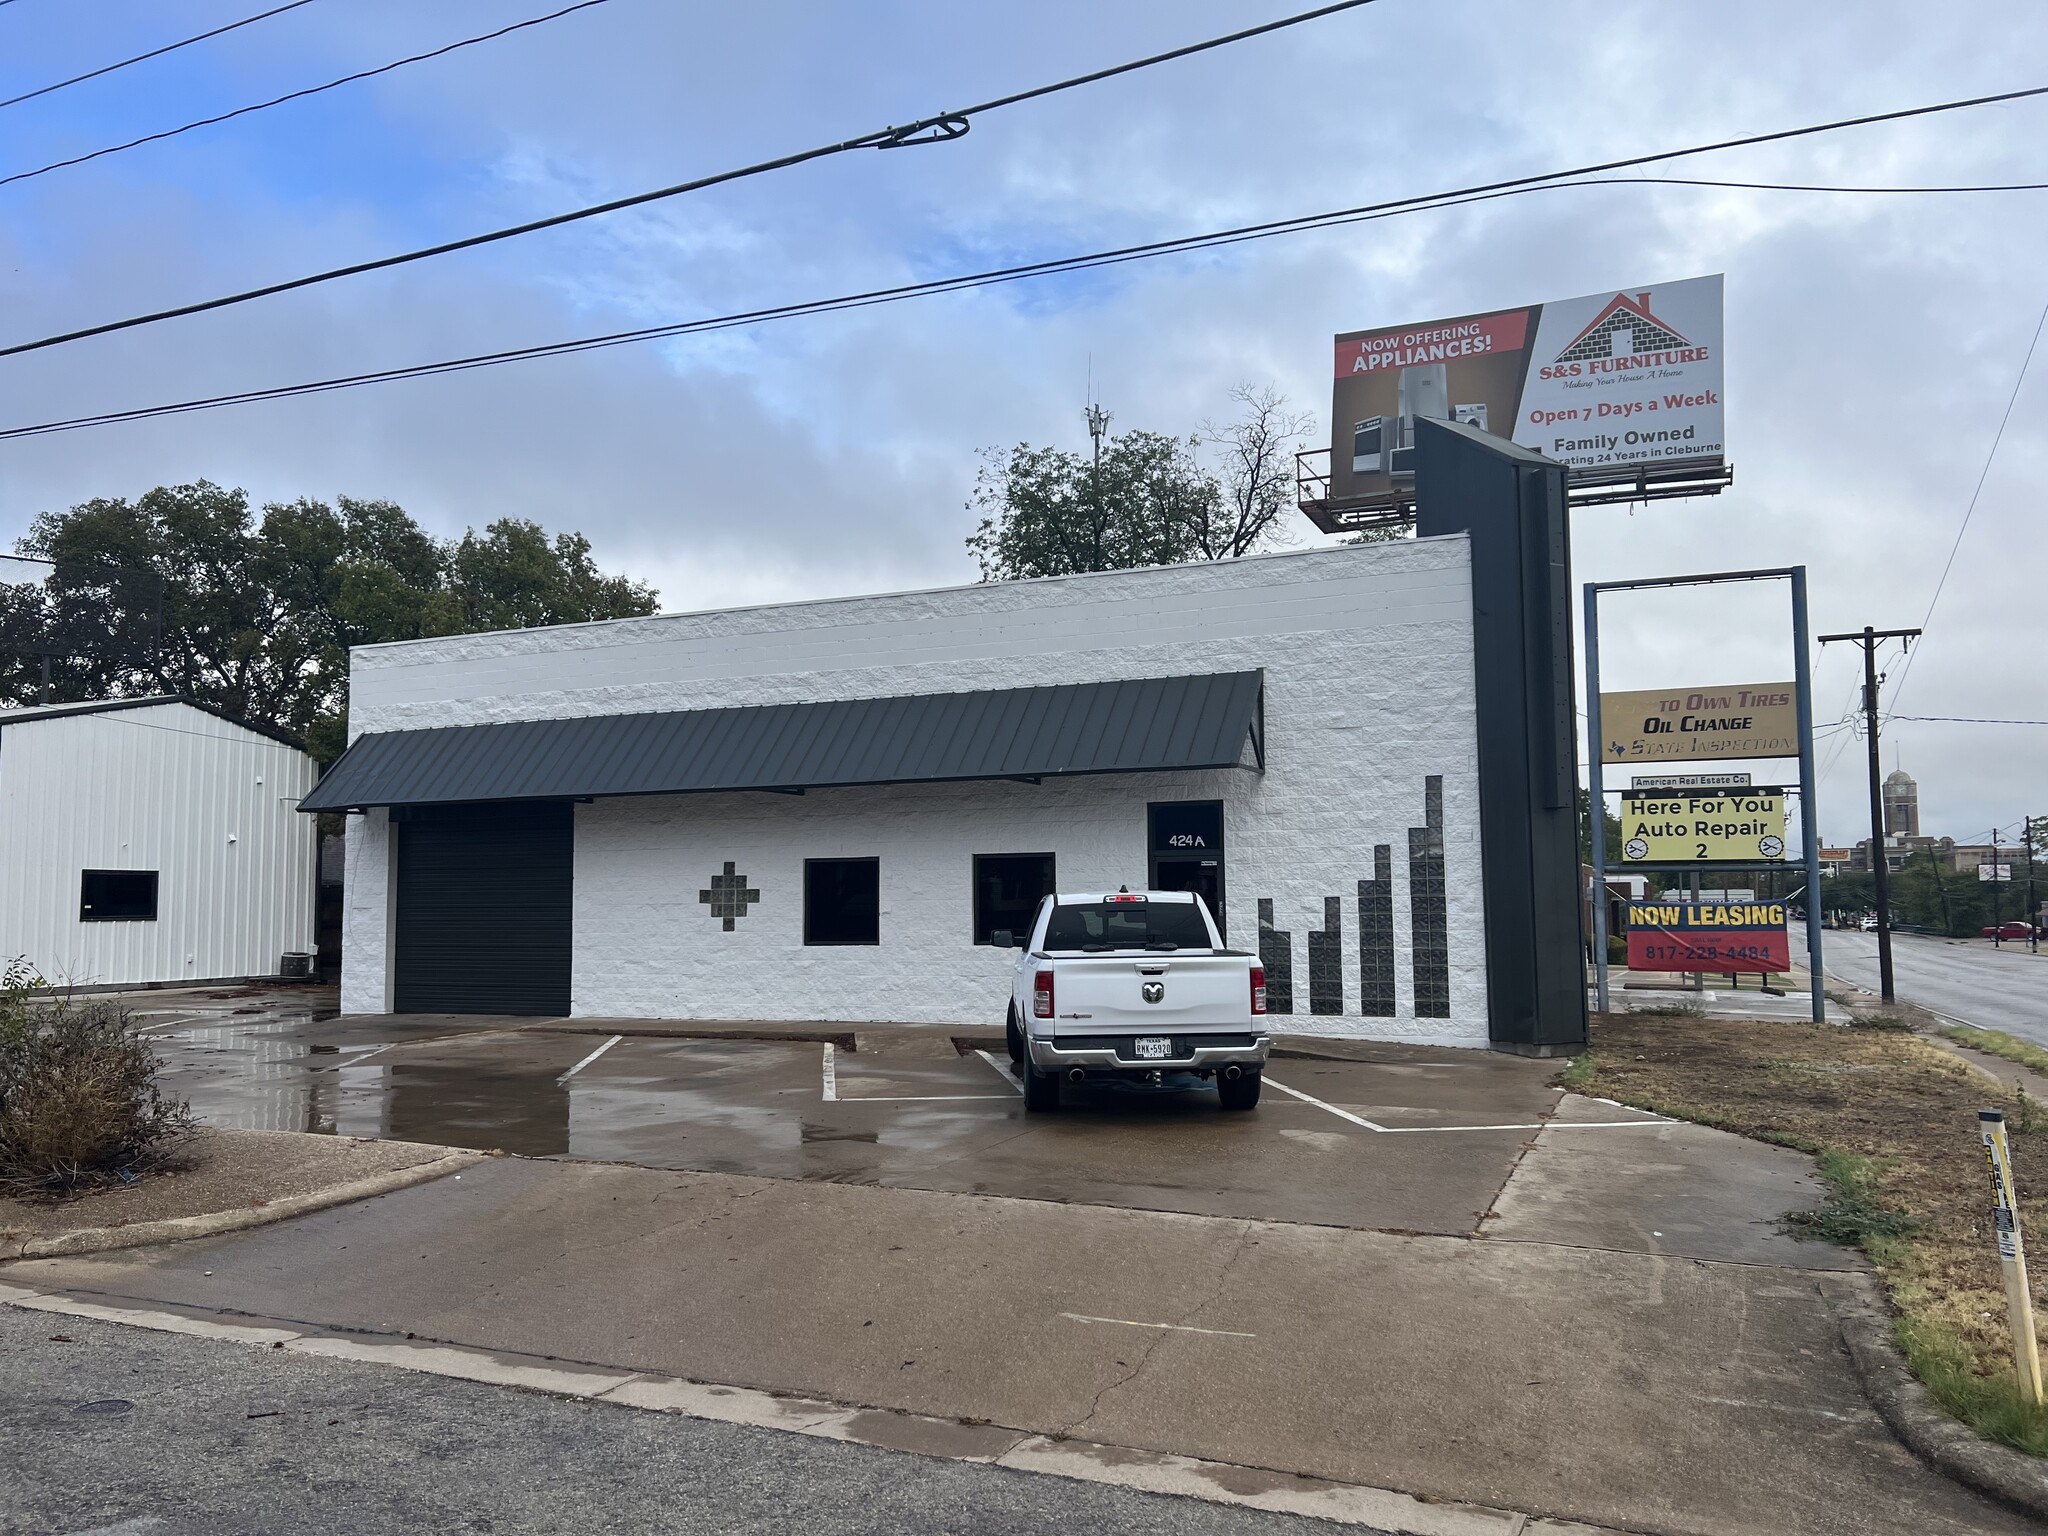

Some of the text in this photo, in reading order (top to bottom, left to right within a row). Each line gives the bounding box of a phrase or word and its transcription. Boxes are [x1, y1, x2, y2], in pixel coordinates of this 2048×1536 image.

[1361, 323, 1480, 353] NOW OFFERING
[1352, 335, 1492, 372] APPLIANCES!
[1539, 347, 1709, 380] S&S FURNITURE
[1563, 369, 1683, 389] Making Your House A Home
[1530, 390, 1718, 426] Open 7 Days a Week
[1554, 425, 1695, 452] Family Owned
[1554, 443, 1721, 465] rating 24 Years in Cleburne
[1659, 691, 1790, 712] TO OWN TIRES
[1643, 715, 1752, 734] OIL CHANGE
[1636, 778, 1677, 786] American
[1679, 777, 1698, 785] Real
[1631, 798, 1773, 815] Here For You
[1634, 819, 1767, 839] Auto Repair
[1696, 843, 1708, 858] 2
[1629, 905, 1784, 926] NOW LEASING
[1646, 946, 1770, 960] 817-228-4484
[1994, 1164, 2003, 1190] GAS
